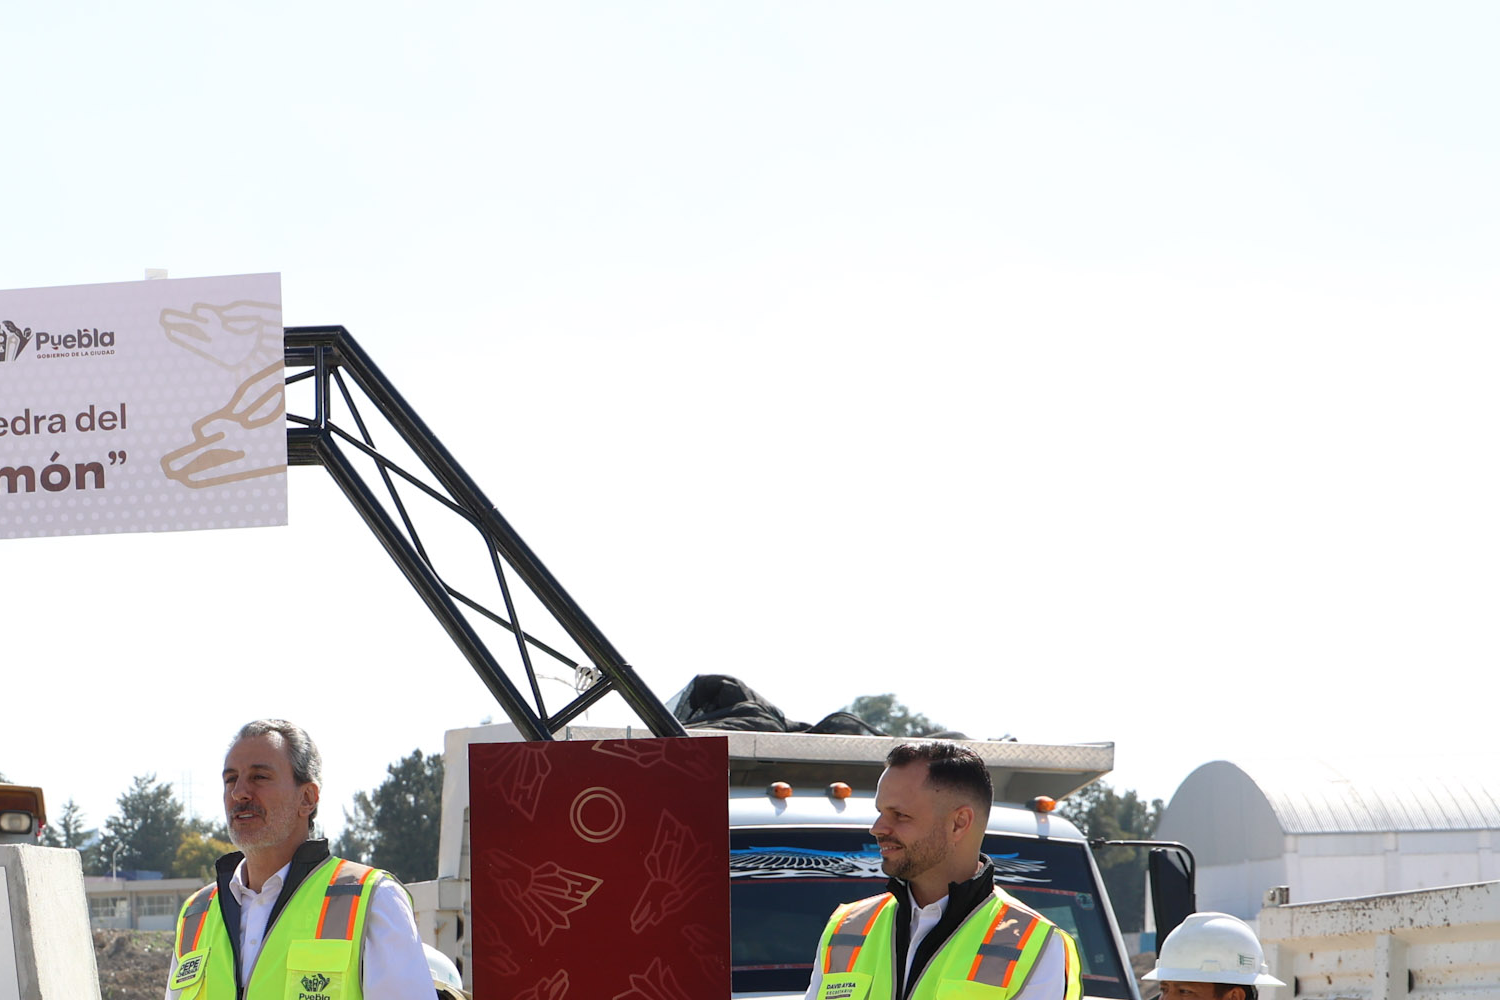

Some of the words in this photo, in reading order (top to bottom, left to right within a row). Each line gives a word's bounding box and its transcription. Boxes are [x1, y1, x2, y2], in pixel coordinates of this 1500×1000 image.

[35, 328, 115, 351] Puebla
[36, 351, 70, 359] GOBIERNO
[81, 350, 89, 358] LA
[90, 349, 116, 357] CIUDAD
[75, 403, 127, 431] del
